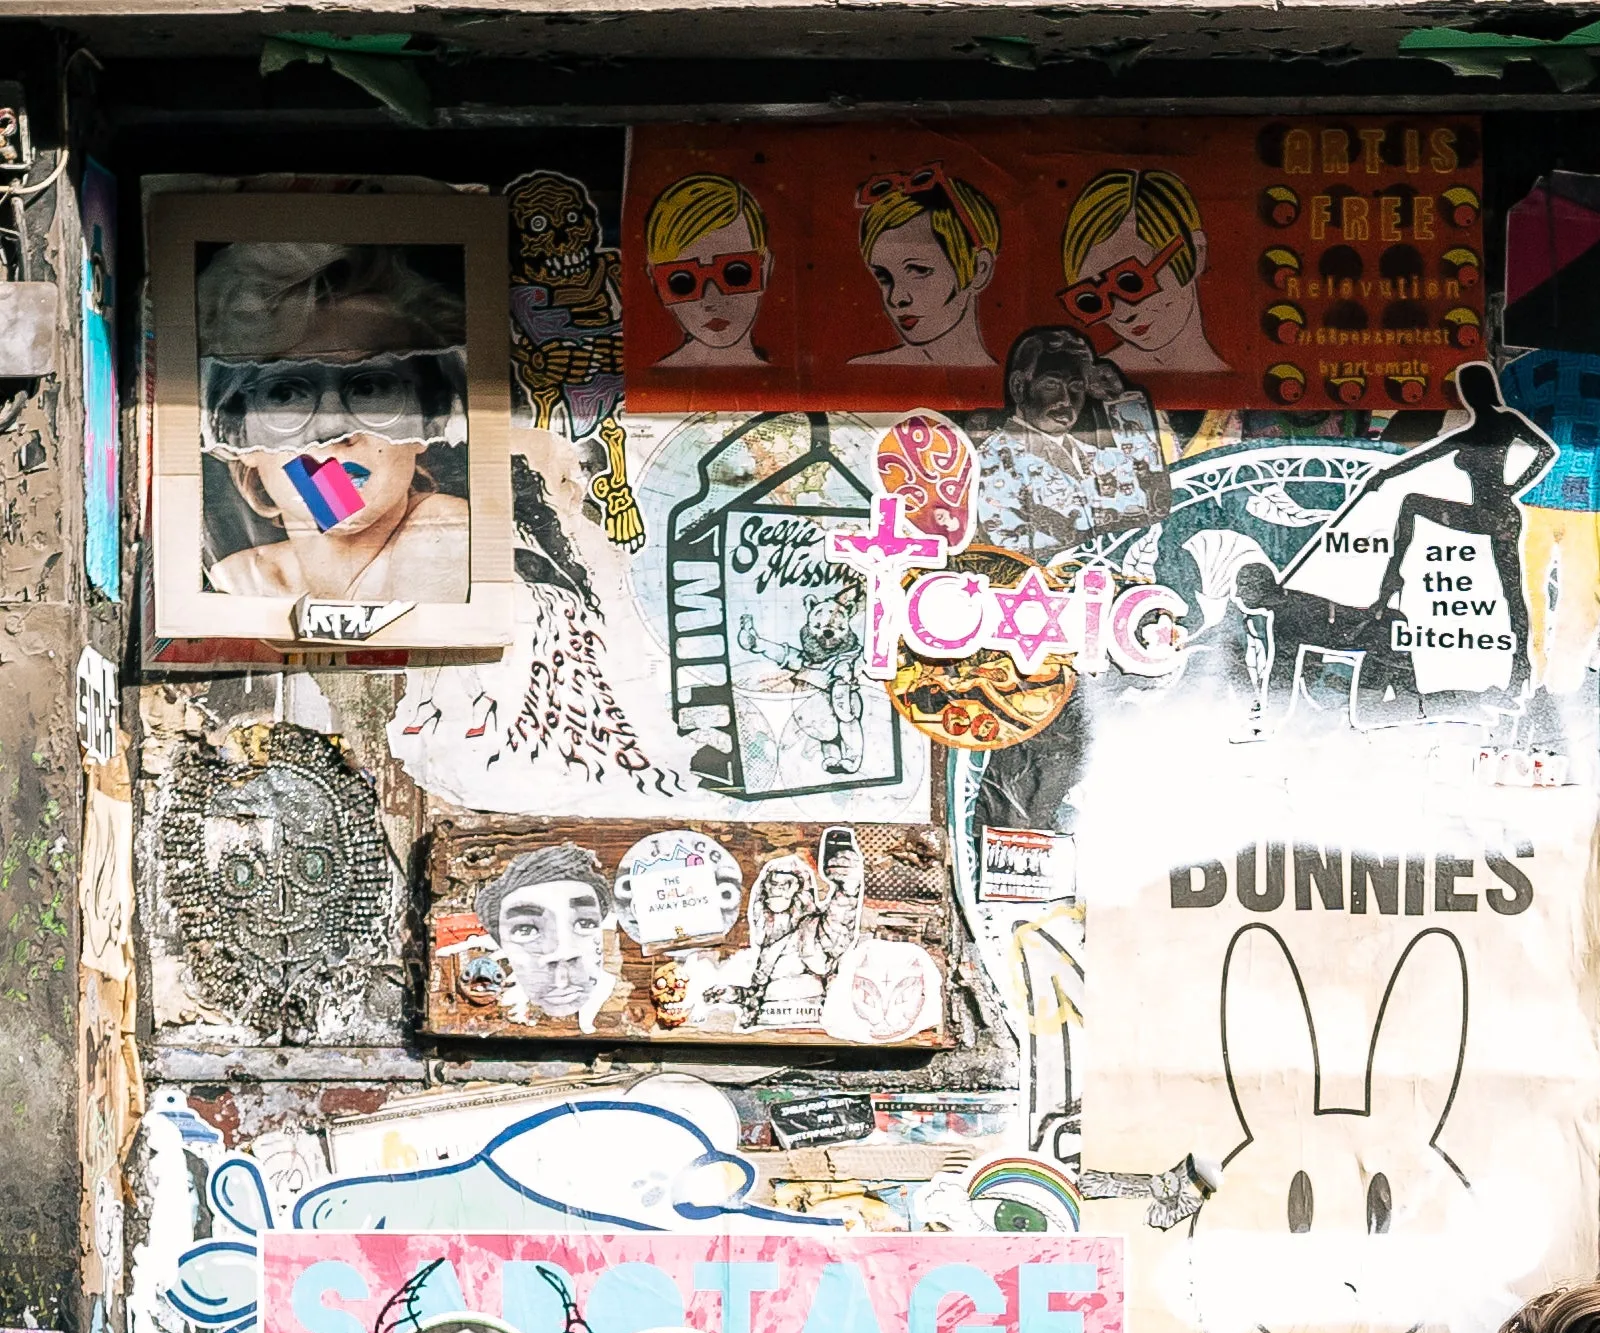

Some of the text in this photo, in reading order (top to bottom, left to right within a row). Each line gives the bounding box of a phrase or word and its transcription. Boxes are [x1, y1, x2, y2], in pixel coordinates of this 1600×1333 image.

[1405, 128, 1459, 174] IS
[1311, 195, 1435, 241] FREE
[1325, 530, 1389, 554] Men
[1425, 542, 1476, 563] are
[1423, 570, 1473, 593] the
[1431, 597, 1497, 616] new
[1396, 624, 1513, 651] bitches
